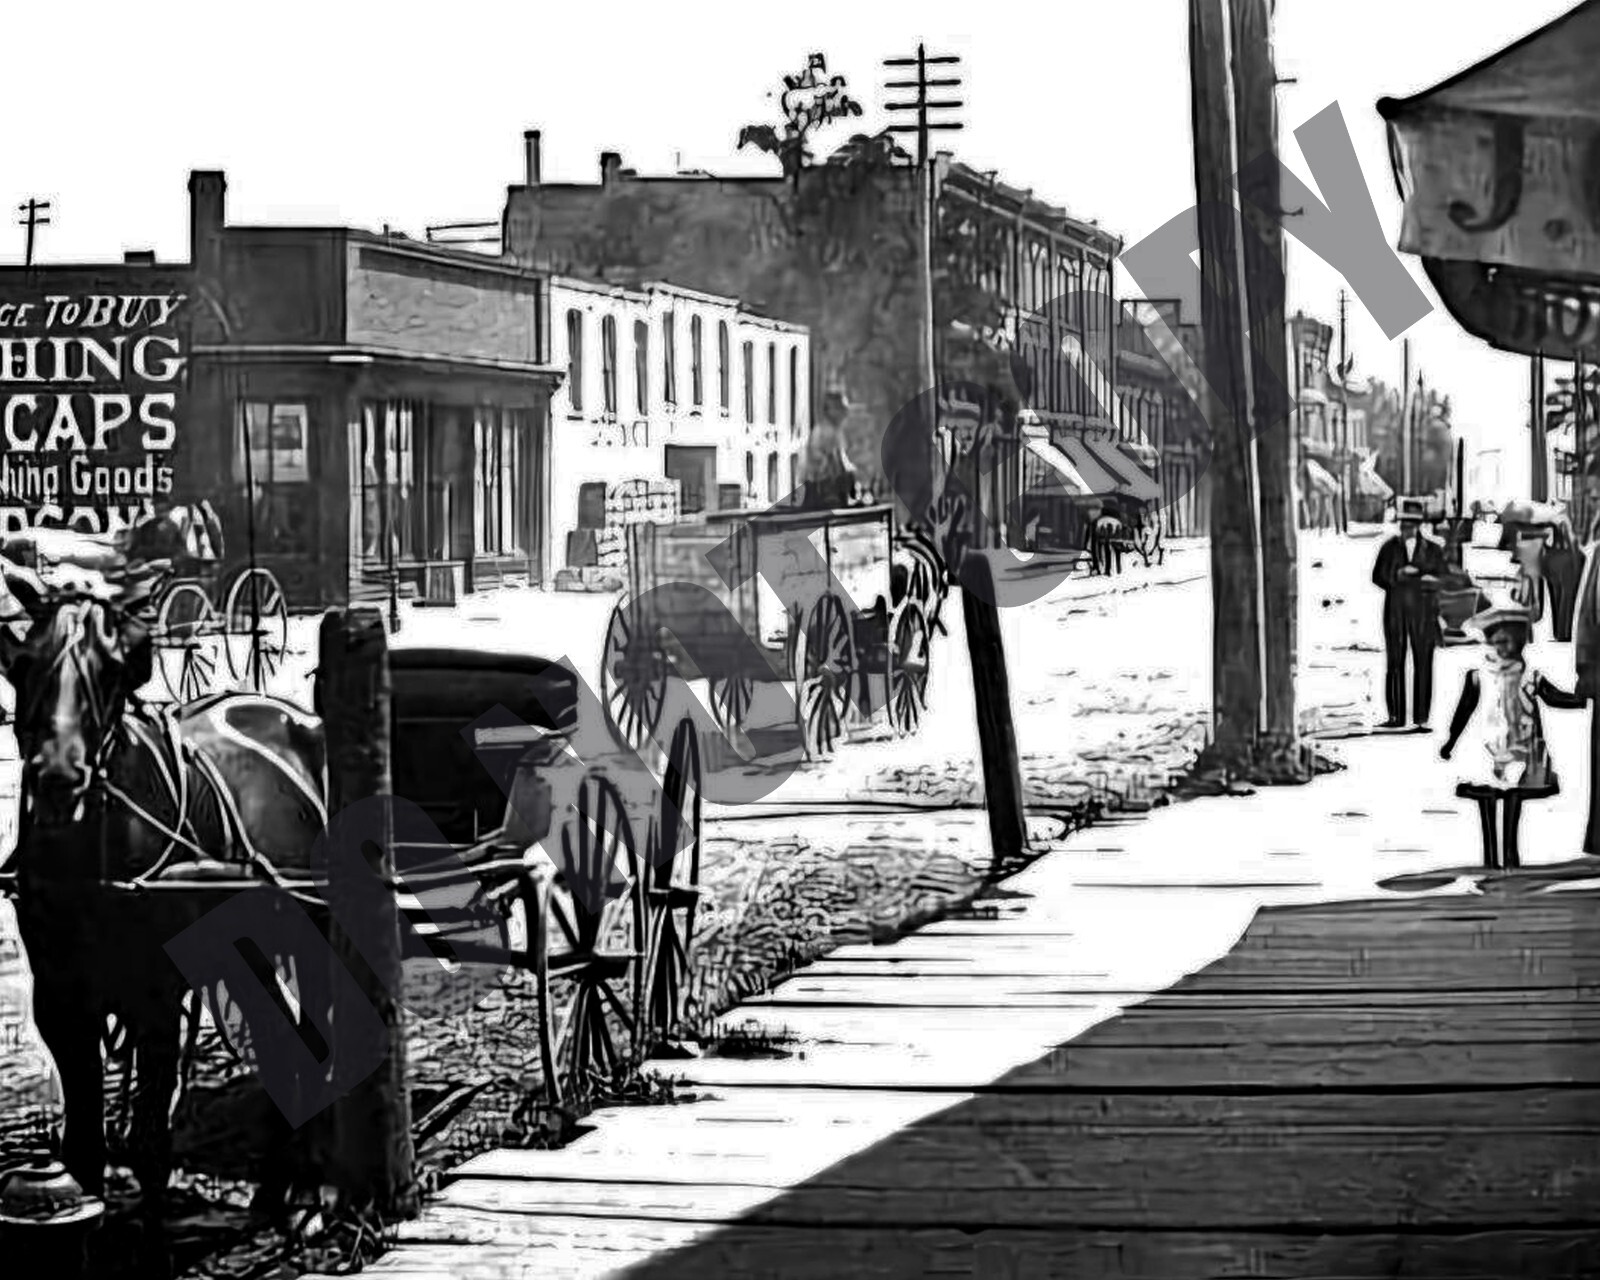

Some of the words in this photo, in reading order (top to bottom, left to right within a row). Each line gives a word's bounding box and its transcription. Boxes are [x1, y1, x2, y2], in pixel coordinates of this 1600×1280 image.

[80, 294, 188, 328] BUY
[0, 336, 188, 382] HING
[4, 393, 177, 452] CAPS
